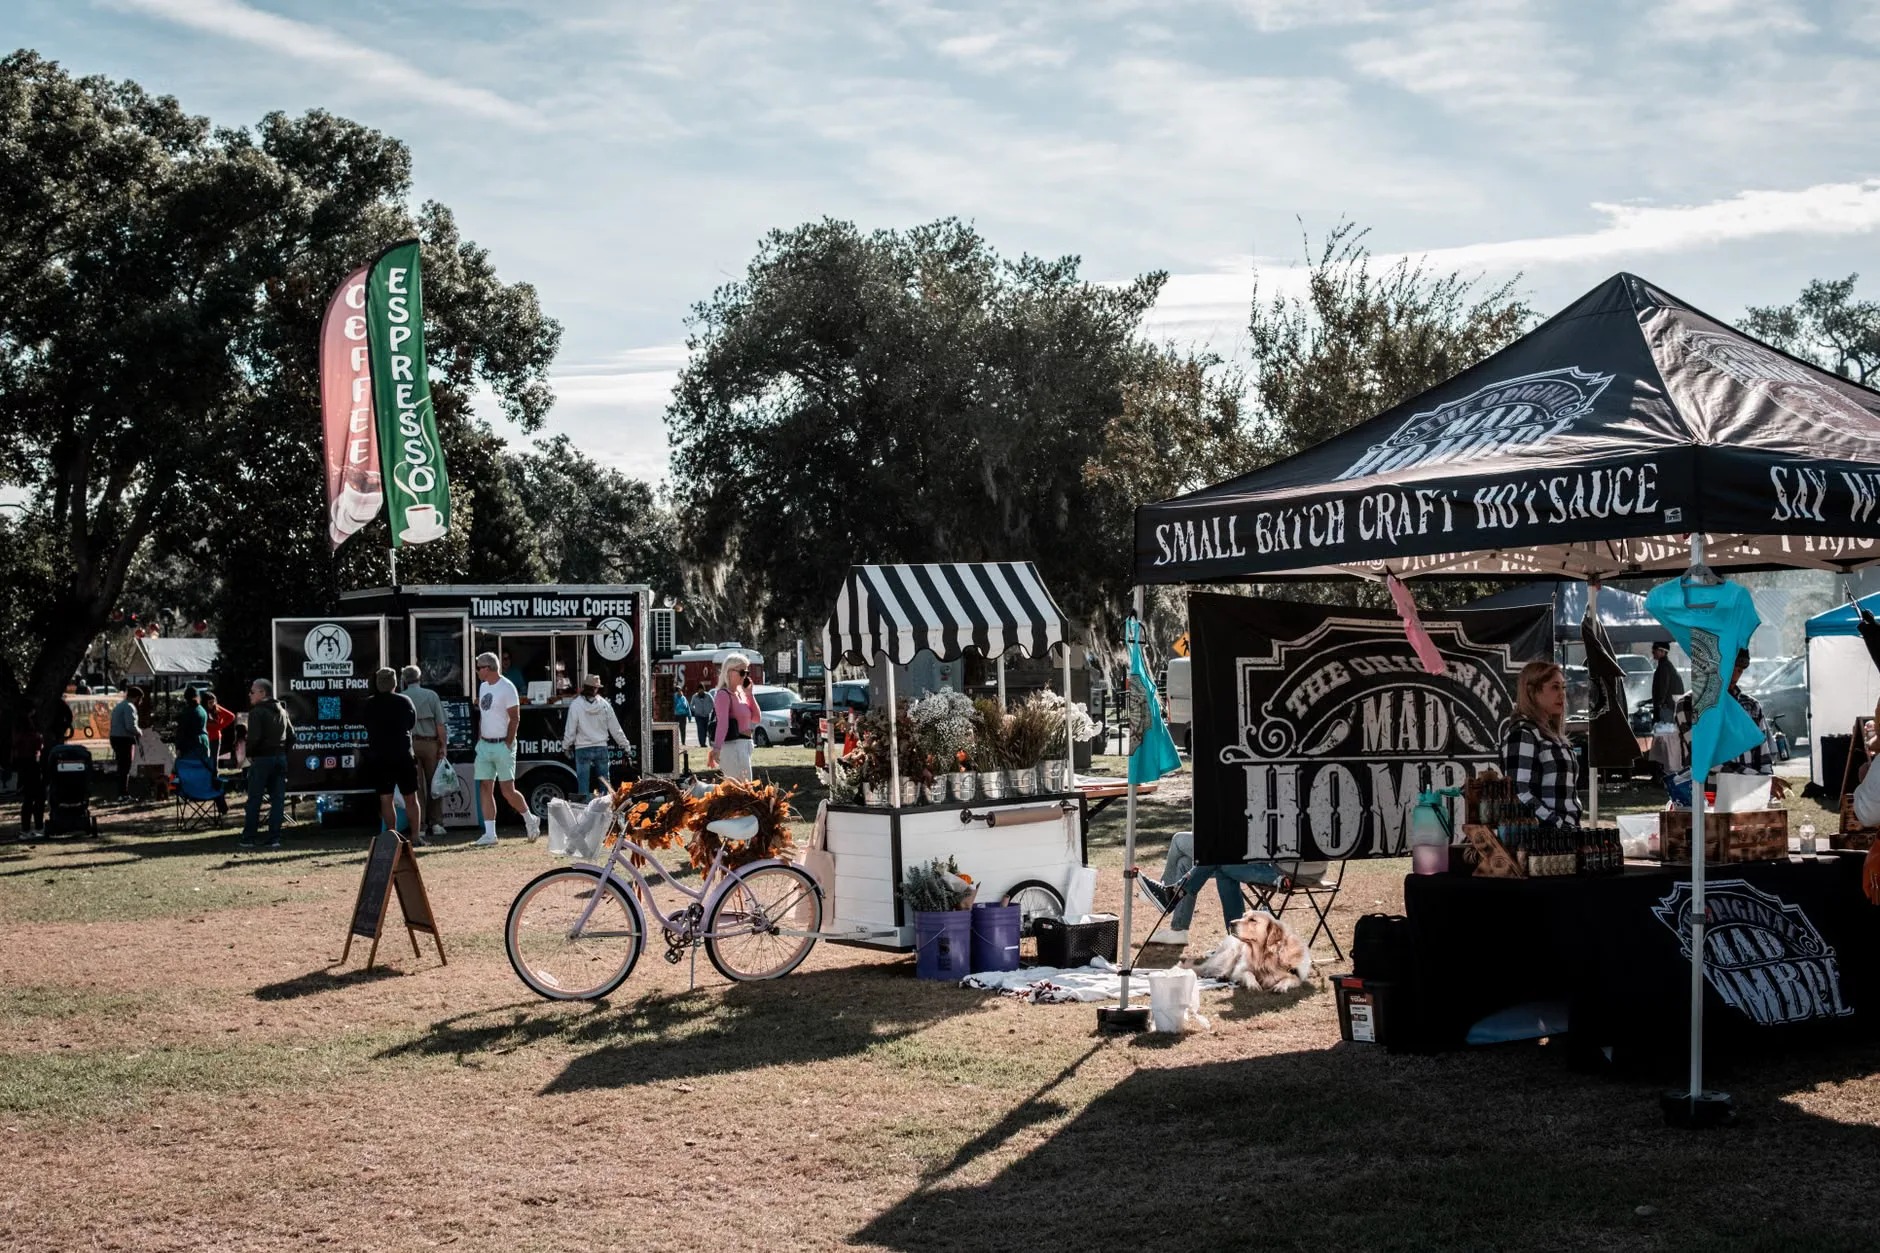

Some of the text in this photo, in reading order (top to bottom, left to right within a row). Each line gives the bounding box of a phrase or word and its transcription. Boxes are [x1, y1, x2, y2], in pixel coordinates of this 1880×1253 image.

[344, 283, 371, 465] COFFEE
[387, 267, 436, 493] ESPRESSO
[1439, 404, 1534, 438] MAD
[1153, 463, 1659, 566] SMALL BATCH CRAFT HOT SAUCE
[1770, 465, 1827, 522] SAY
[471, 597, 633, 617] THIRSTY HUSKY COFFEE
[290, 678, 369, 691] FOLLOW THE PACK
[1284, 660, 1352, 720] THE
[344, 723, 367, 731] Caterin
[519, 739, 564, 755] THE PAC
[1361, 690, 1450, 753] MAD
